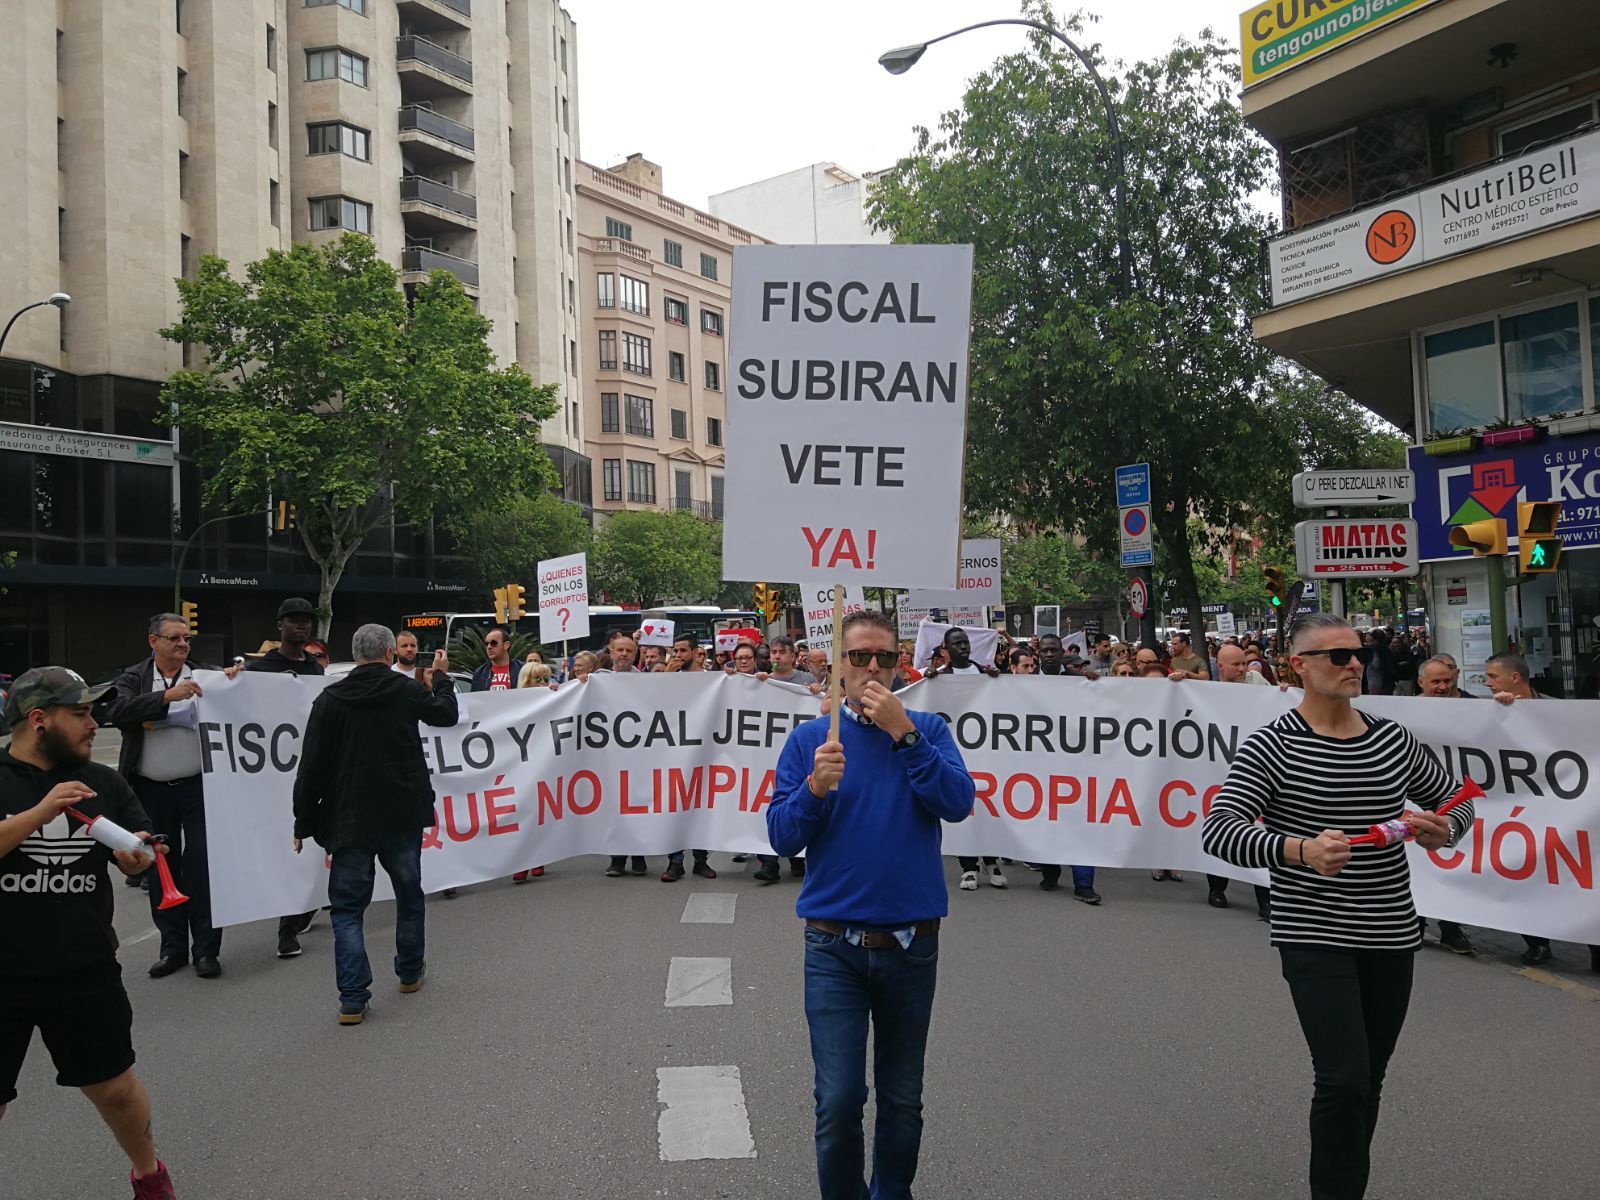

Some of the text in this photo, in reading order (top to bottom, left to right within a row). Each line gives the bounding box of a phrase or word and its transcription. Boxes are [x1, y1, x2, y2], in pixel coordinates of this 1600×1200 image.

[1251, 0, 1346, 42] CUR
[1440, 147, 1577, 218] NutriBell
[1443, 182, 1578, 234] CENTRO MÉDICO ESTÉTICO
[1539, 206, 1554, 216] Cita
[1374, 221, 1408, 254] NB
[1314, 277, 1322, 285] DE
[761, 281, 936, 324] FISCAL
[737, 358, 957, 403] SUBIRAN
[780, 443, 905, 487] VETE
[1305, 478, 1315, 491] C/
[1318, 478, 1337, 490] PERE
[1339, 476, 1387, 490] DEZCALLAR
[1393, 475, 1410, 489] NET
[1557, 510, 1574, 523] el.:
[800, 526, 877, 570] YA!
[1322, 523, 1407, 559] MATAS
[960, 557, 998, 569] ERNOS
[210, 576, 258, 586] BancaMarch
[541, 565, 583, 584] ¿QUIENES
[434, 584, 470, 592] BancaMar
[542, 579, 583, 596] SON LOS
[540, 592, 588, 609] CORRUPTOS
[1132, 591, 1142, 604] 50
[556, 607, 571, 632] ?
[808, 603, 861, 621] MENTRAS
[809, 624, 833, 638] FAM
[810, 640, 833, 650] DEST
[199, 721, 300, 774] FISC
[507, 723, 535, 763] Y
[550, 710, 702, 756] FISCAL
[935, 709, 1239, 765] ORRUPCIÓN
[1420, 743, 1589, 800] NDRO
[537, 769, 603, 826] NO
[967, 771, 1142, 827] ROPIA
[0, 868, 97, 894] adidas
